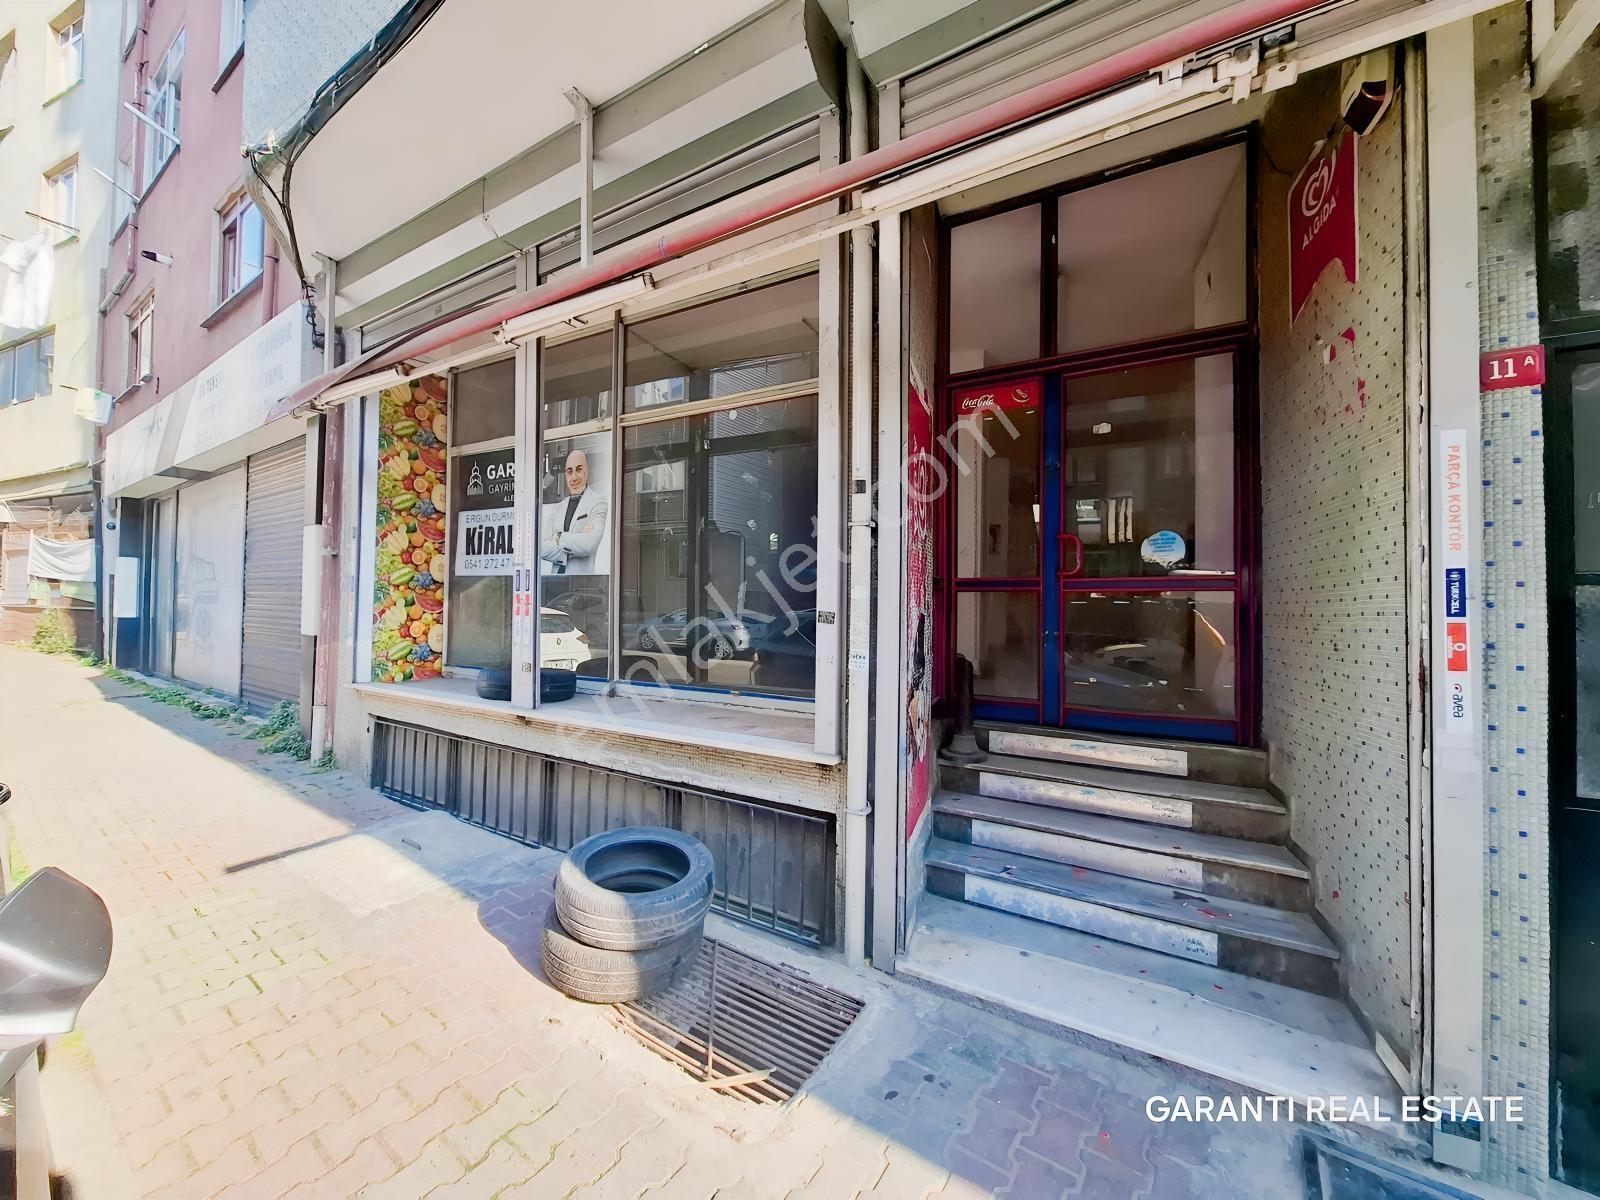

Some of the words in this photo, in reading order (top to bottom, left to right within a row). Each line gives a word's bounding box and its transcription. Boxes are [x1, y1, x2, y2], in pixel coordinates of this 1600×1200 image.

[1302, 194, 1337, 250] ALGIDA
[1489, 358, 1517, 379] 11
[1524, 355, 1535, 367] A
[1446, 444, 1460, 490] PARÇA
[1453, 694, 1464, 718] avea
